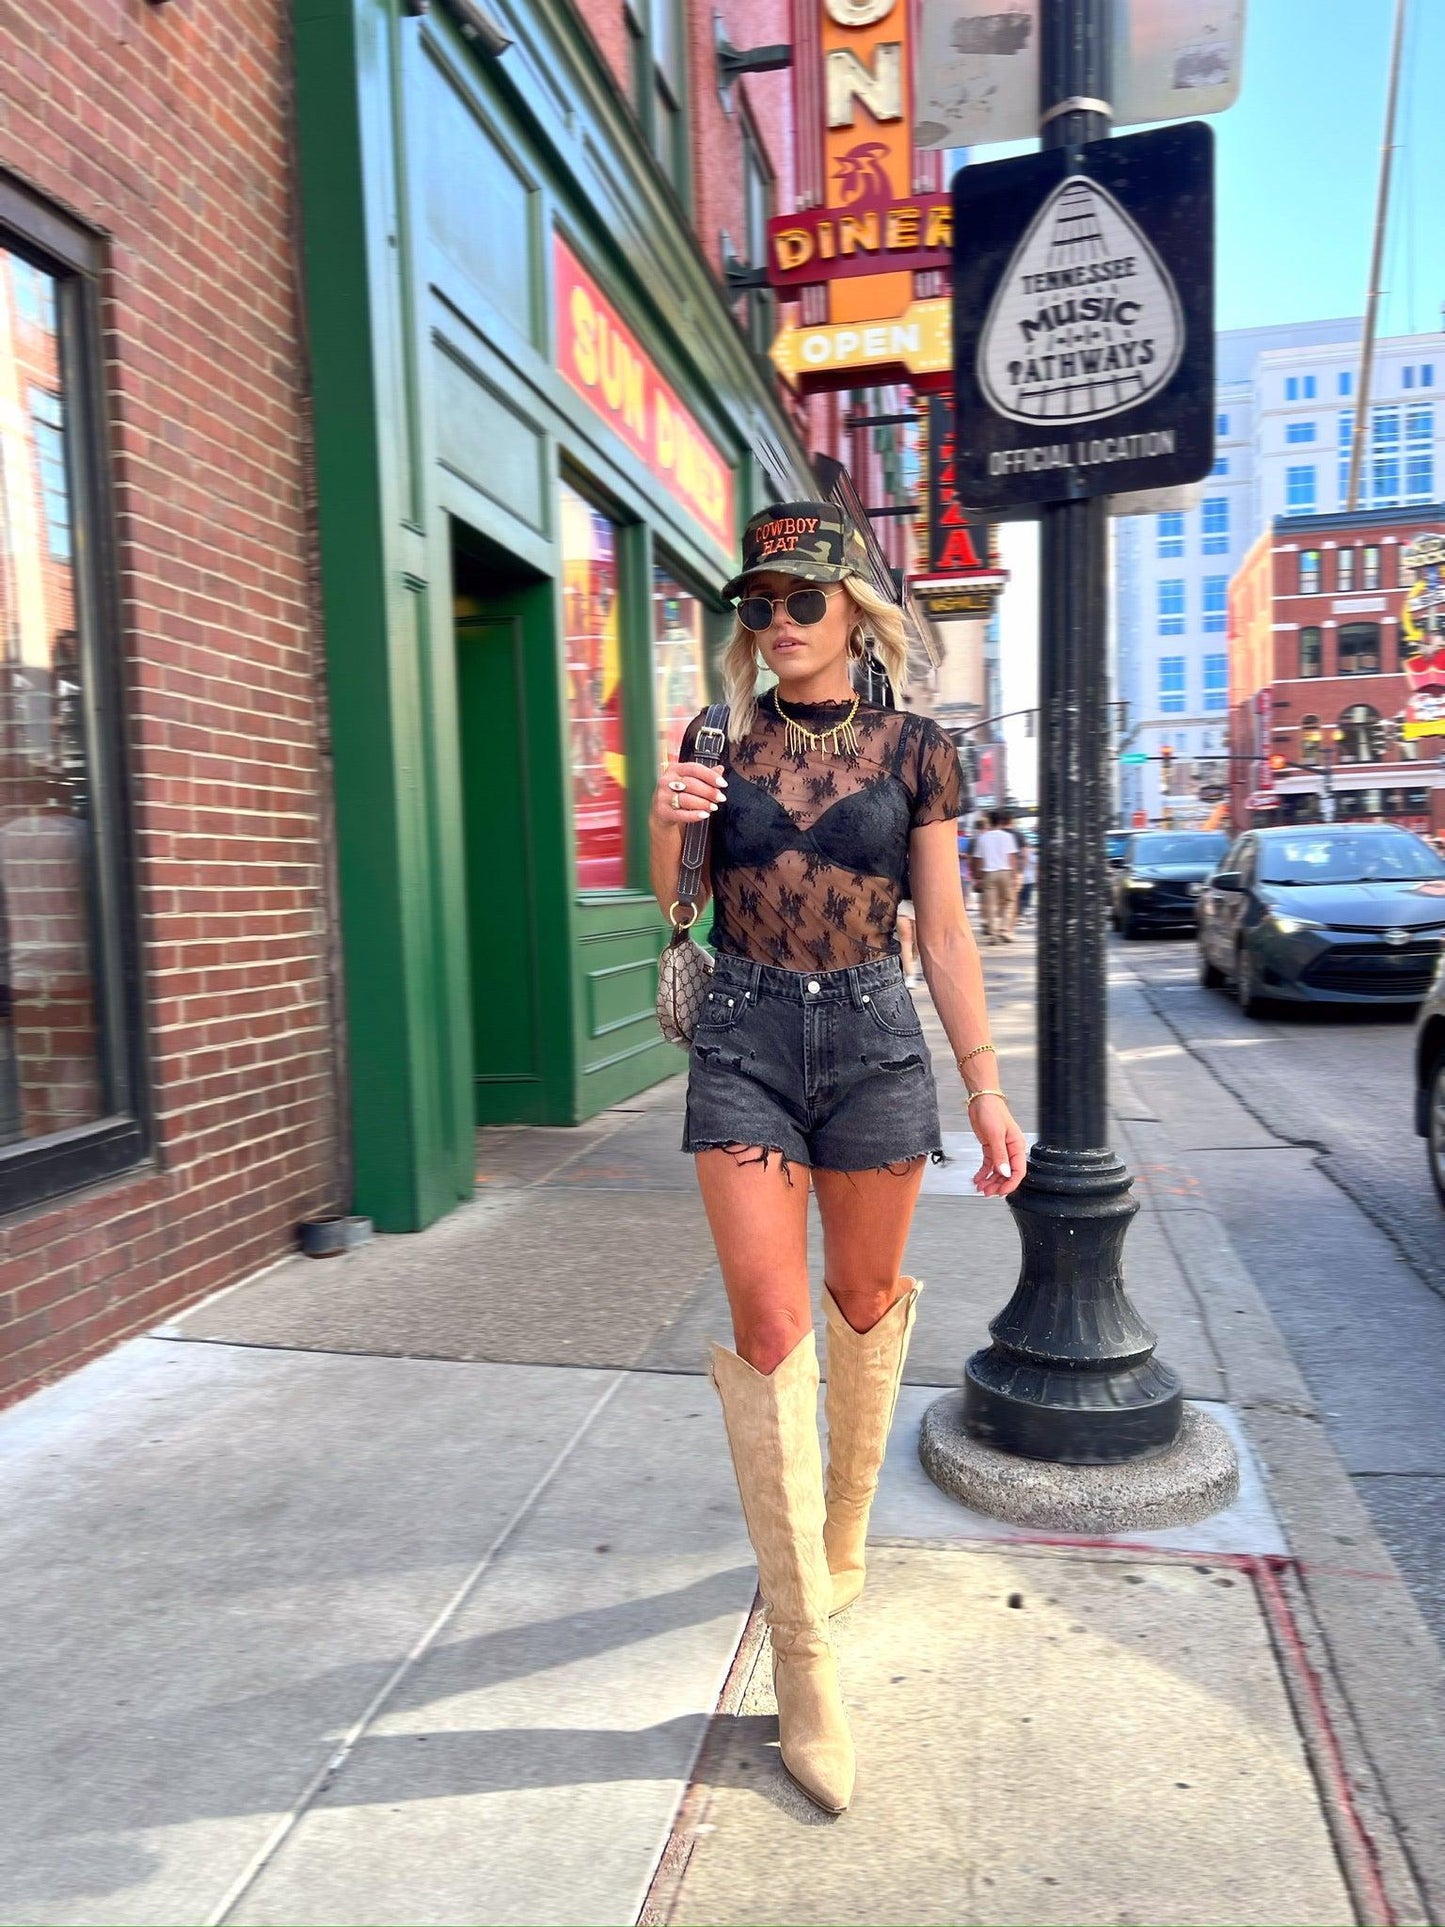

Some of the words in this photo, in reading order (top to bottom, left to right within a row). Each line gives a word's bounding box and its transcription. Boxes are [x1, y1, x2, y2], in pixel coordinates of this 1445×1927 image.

[1021, 257, 1136, 295] TENNESSEE
[1017, 297, 1145, 342] MUSIC
[571, 284, 646, 442] SUN
[801, 323, 921, 364] OPEN
[1007, 339, 1156, 386] PATHWAYS
[988, 444, 1075, 476] OFFICIAL
[1078, 430, 1177, 467] LOCATION
[755, 517, 819, 542] COWBOY
[761, 536, 799, 556] HAT
